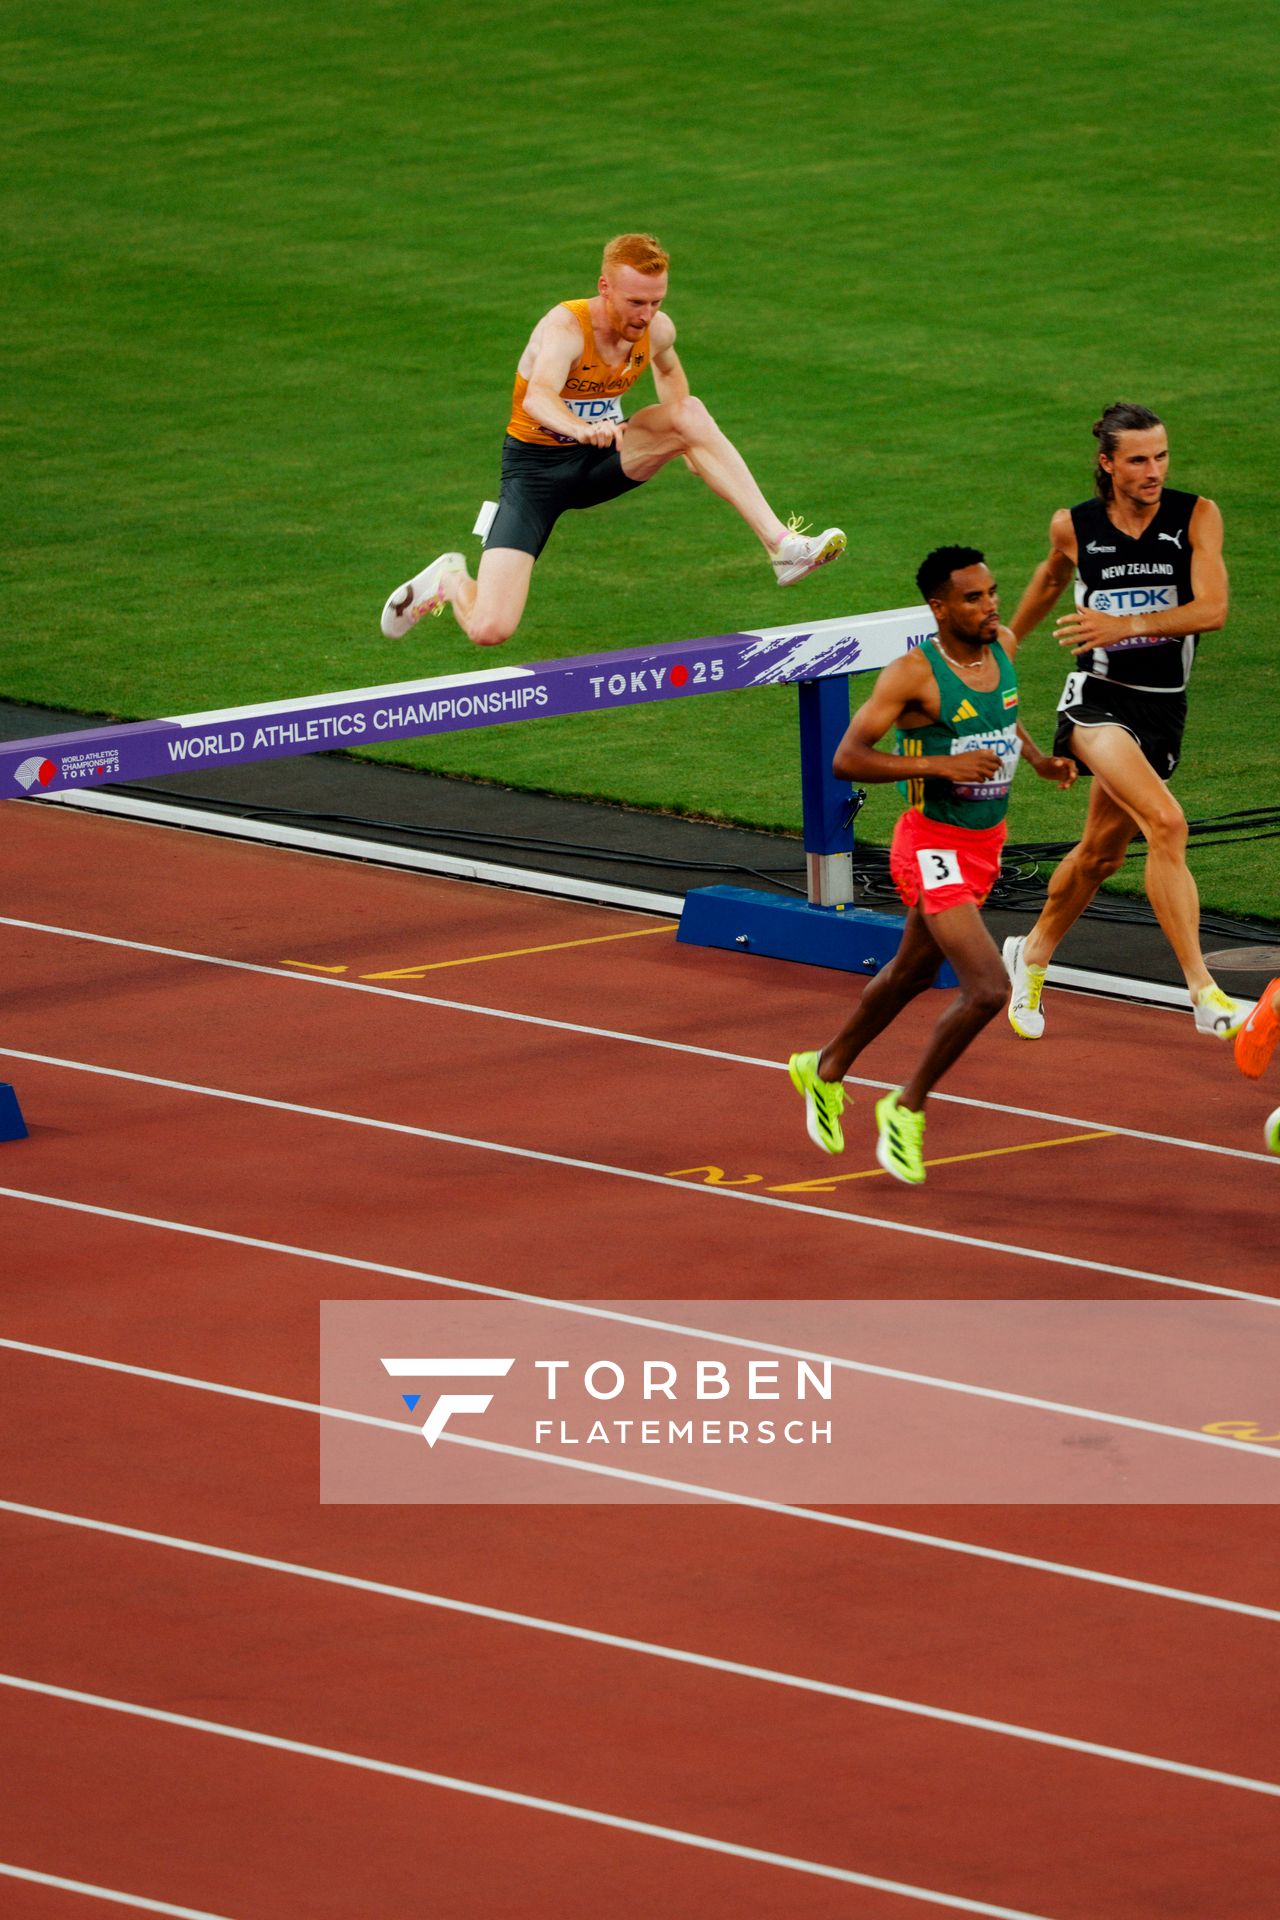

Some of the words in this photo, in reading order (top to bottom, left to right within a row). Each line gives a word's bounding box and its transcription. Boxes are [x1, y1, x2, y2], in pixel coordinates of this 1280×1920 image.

[575, 399, 614, 417] TDK
[1101, 564, 1126, 580] NEW
[1127, 563, 1174, 575] ZEALAND
[1110, 588, 1170, 609] TDK
[692, 659, 724, 684] 25
[168, 731, 245, 761] WORLD
[252, 712, 366, 749] ATHLETICS
[373, 685, 549, 730] CHAMPIONSHIPS
[61, 756, 84, 764] WORLD
[85, 749, 119, 760] ATHLETICS
[61, 756, 119, 771] CHAMPIONSHIPS
[931, 855, 949, 880] 3
